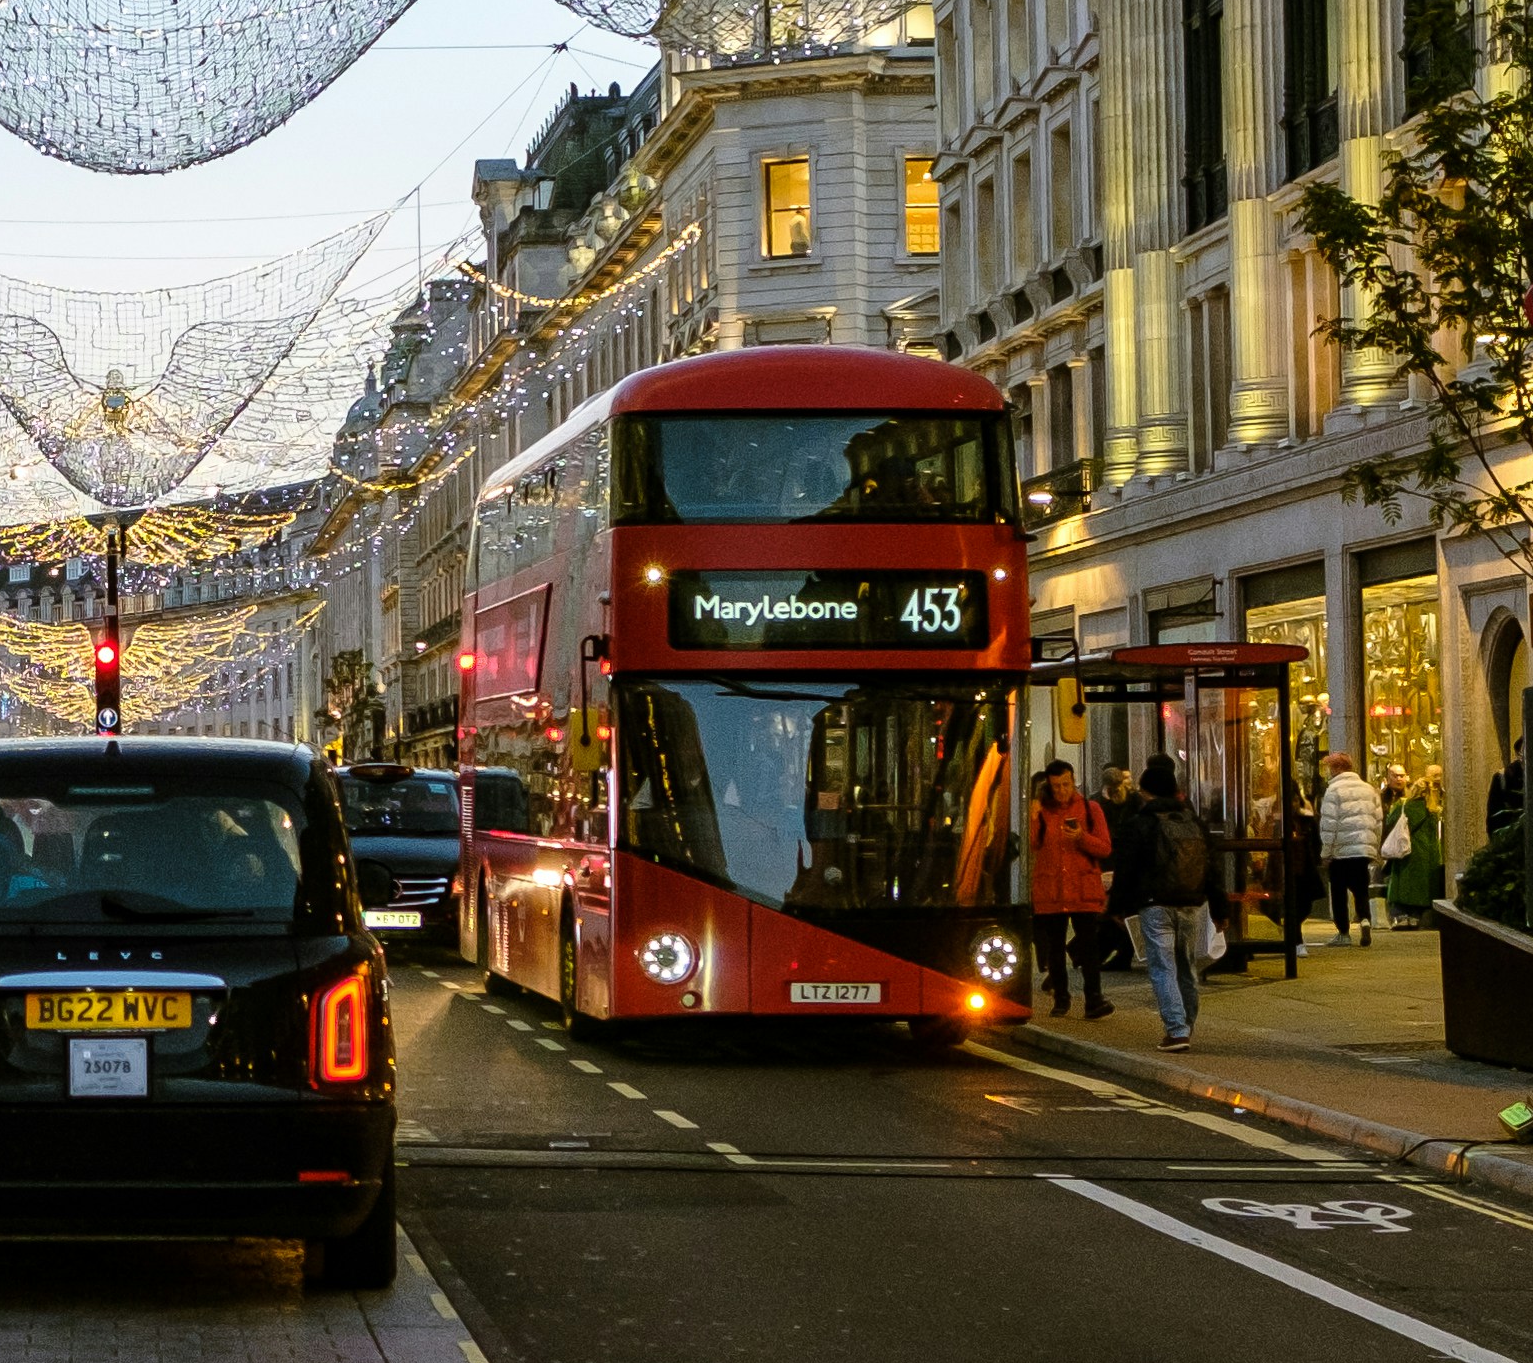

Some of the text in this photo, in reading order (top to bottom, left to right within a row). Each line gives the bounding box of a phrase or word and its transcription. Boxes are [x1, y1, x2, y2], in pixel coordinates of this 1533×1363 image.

[694, 588, 961, 633] Marylebone 453
[57, 951, 163, 960] LEVC
[801, 985, 870, 1000] LTZ 1277
[38, 995, 179, 1023] BG22 WVC
[85, 1060, 131, 1074] 25078
